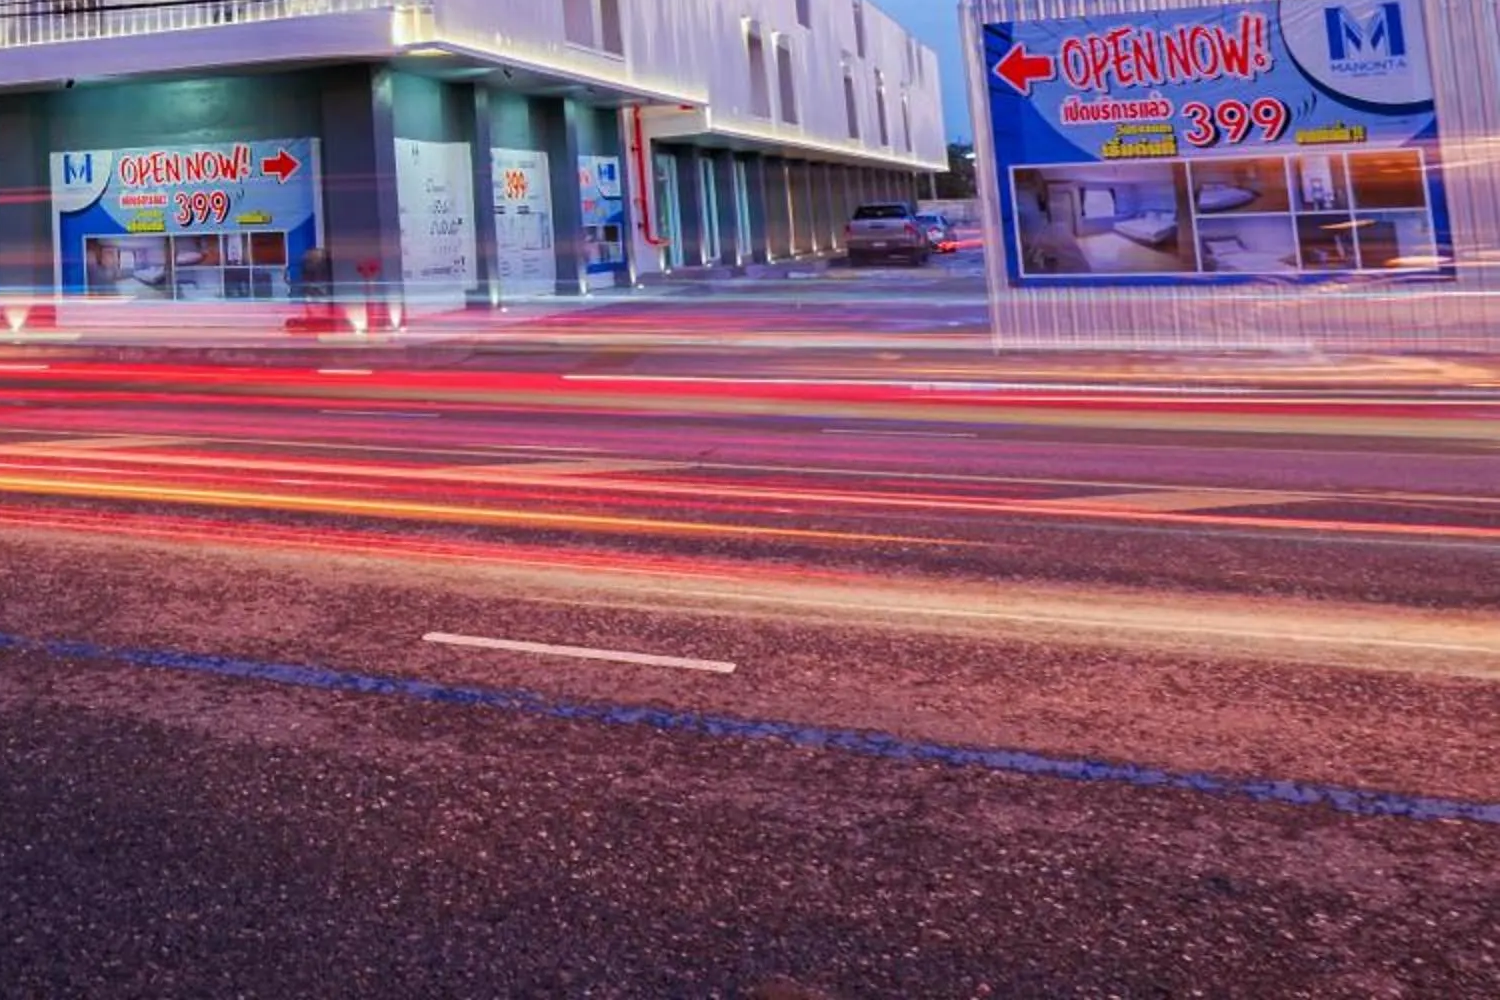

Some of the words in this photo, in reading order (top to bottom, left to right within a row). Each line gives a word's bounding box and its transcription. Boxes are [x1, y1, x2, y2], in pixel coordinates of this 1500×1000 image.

[1324, 1, 1406, 60] M
[1061, 26, 1160, 89] OPEN
[1183, 98, 1287, 145] 399
[120, 152, 181, 185] OPEN
[174, 191, 228, 225] 399
